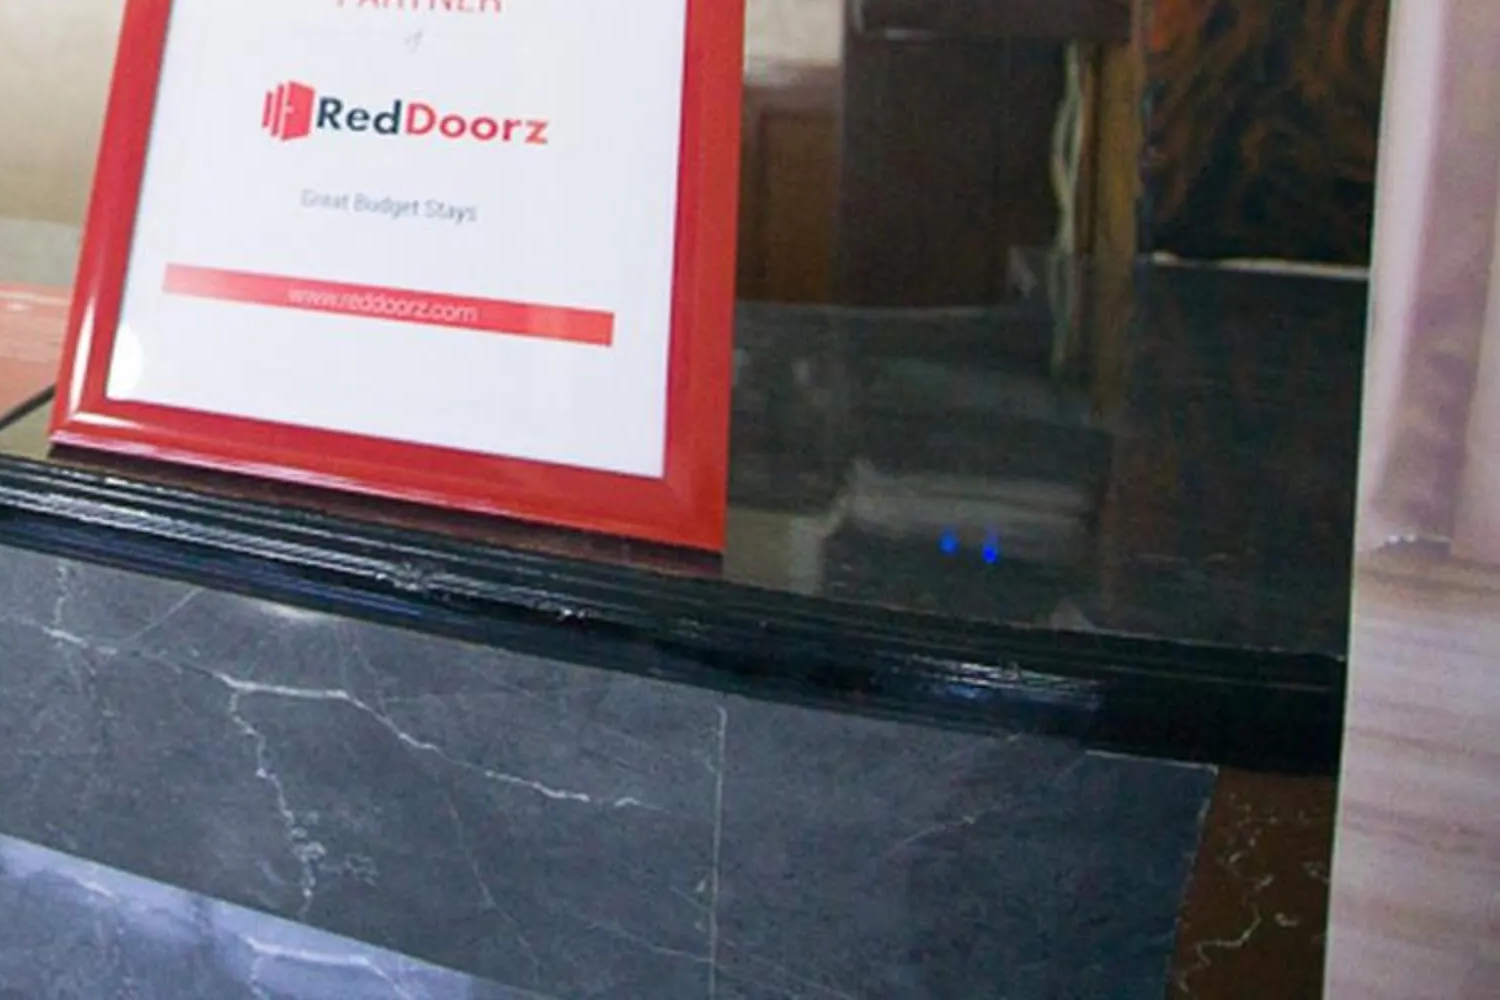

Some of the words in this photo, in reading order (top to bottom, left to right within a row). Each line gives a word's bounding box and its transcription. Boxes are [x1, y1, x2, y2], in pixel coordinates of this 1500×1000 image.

[315, 97, 549, 145] RedDoorz
[300, 188, 350, 211] Great
[354, 192, 420, 220] Budget
[424, 199, 478, 224] Stays
[289, 288, 477, 323] www.reddoorz.com
